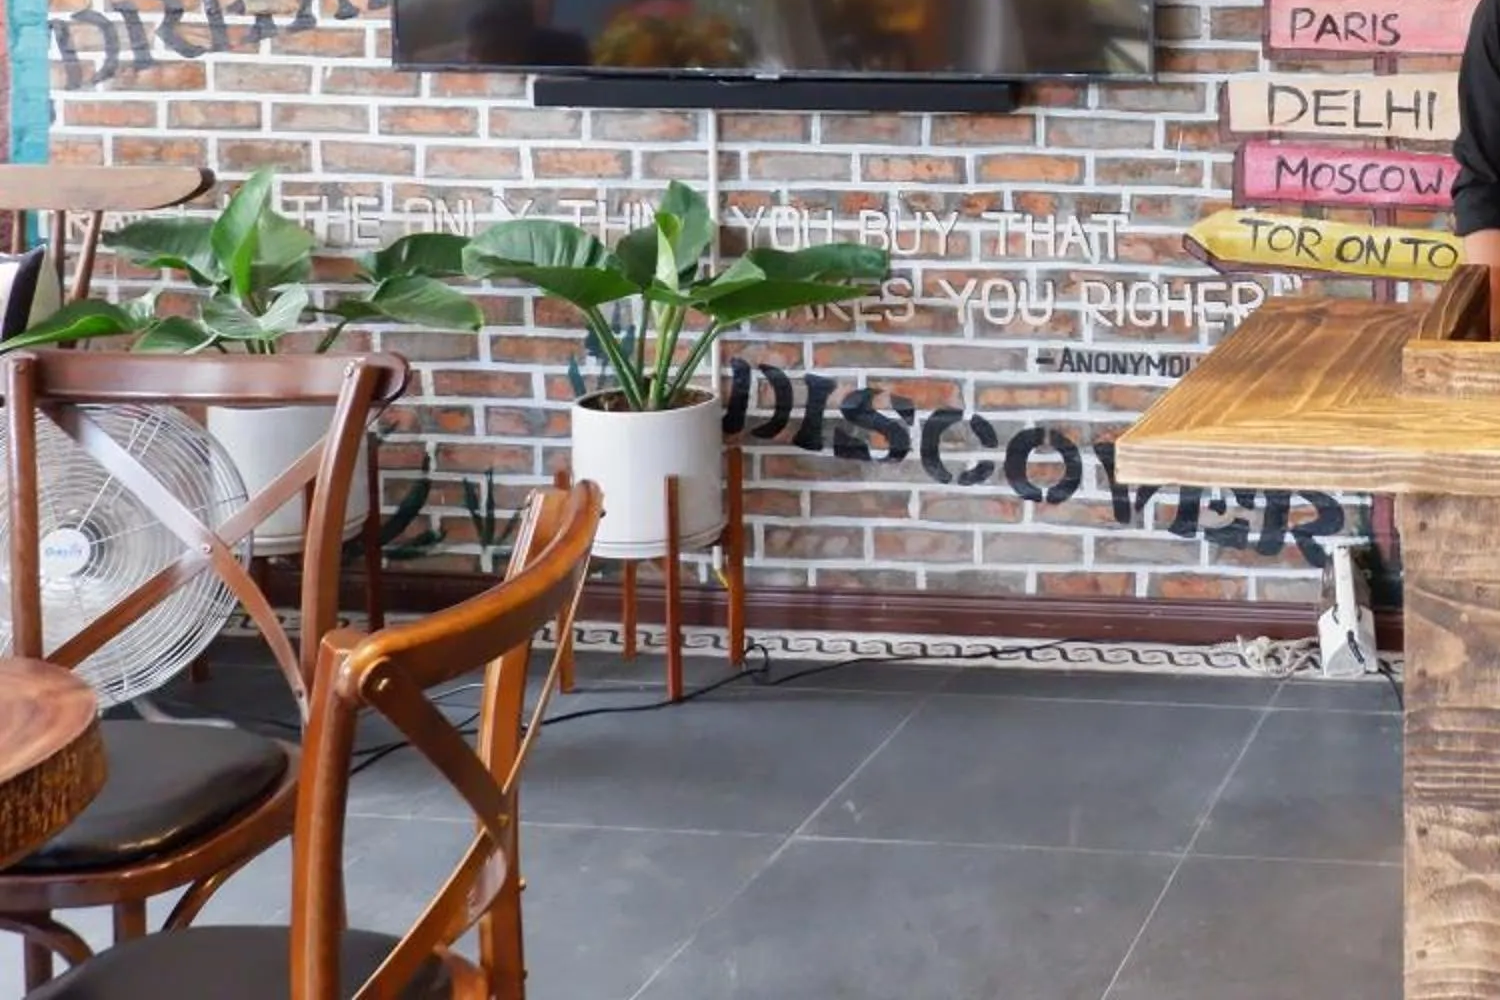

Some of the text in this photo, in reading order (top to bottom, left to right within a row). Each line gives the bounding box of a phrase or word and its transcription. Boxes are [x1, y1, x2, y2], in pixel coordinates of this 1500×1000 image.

[1290, 7, 1401, 46] PARIS
[1266, 82, 1437, 131] DELHI
[1275, 156, 1443, 195] MOSCOW
[284, 195, 382, 245] THE
[730, 205, 833, 253] YOU
[858, 208, 959, 257] BUY
[980, 211, 1131, 261] THAT
[937, 278, 1054, 326] YOU
